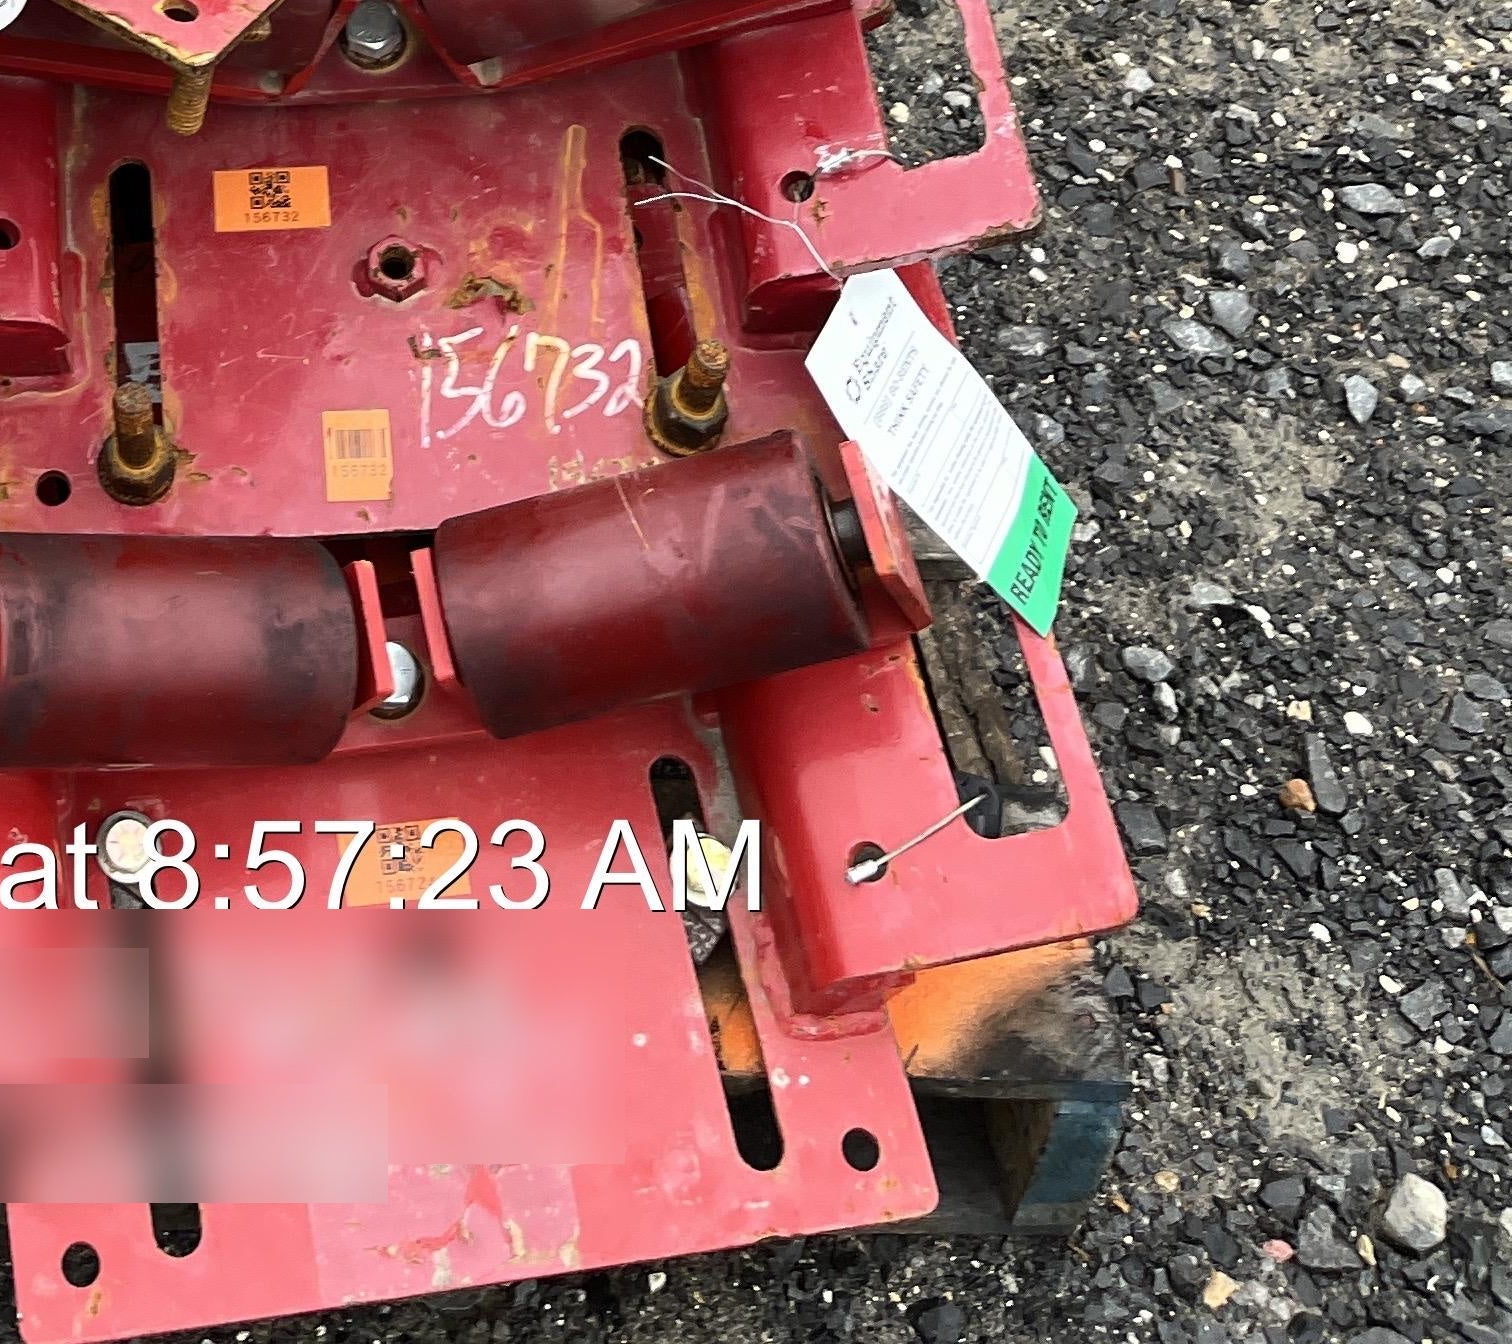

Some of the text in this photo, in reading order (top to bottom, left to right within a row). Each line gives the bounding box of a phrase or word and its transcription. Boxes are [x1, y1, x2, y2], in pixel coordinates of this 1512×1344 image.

[244, 211, 300, 224] 156732
[420, 324, 645, 449] 156732
[1010, 539, 1045, 605] READY
[1033, 518, 1048, 547] TO
